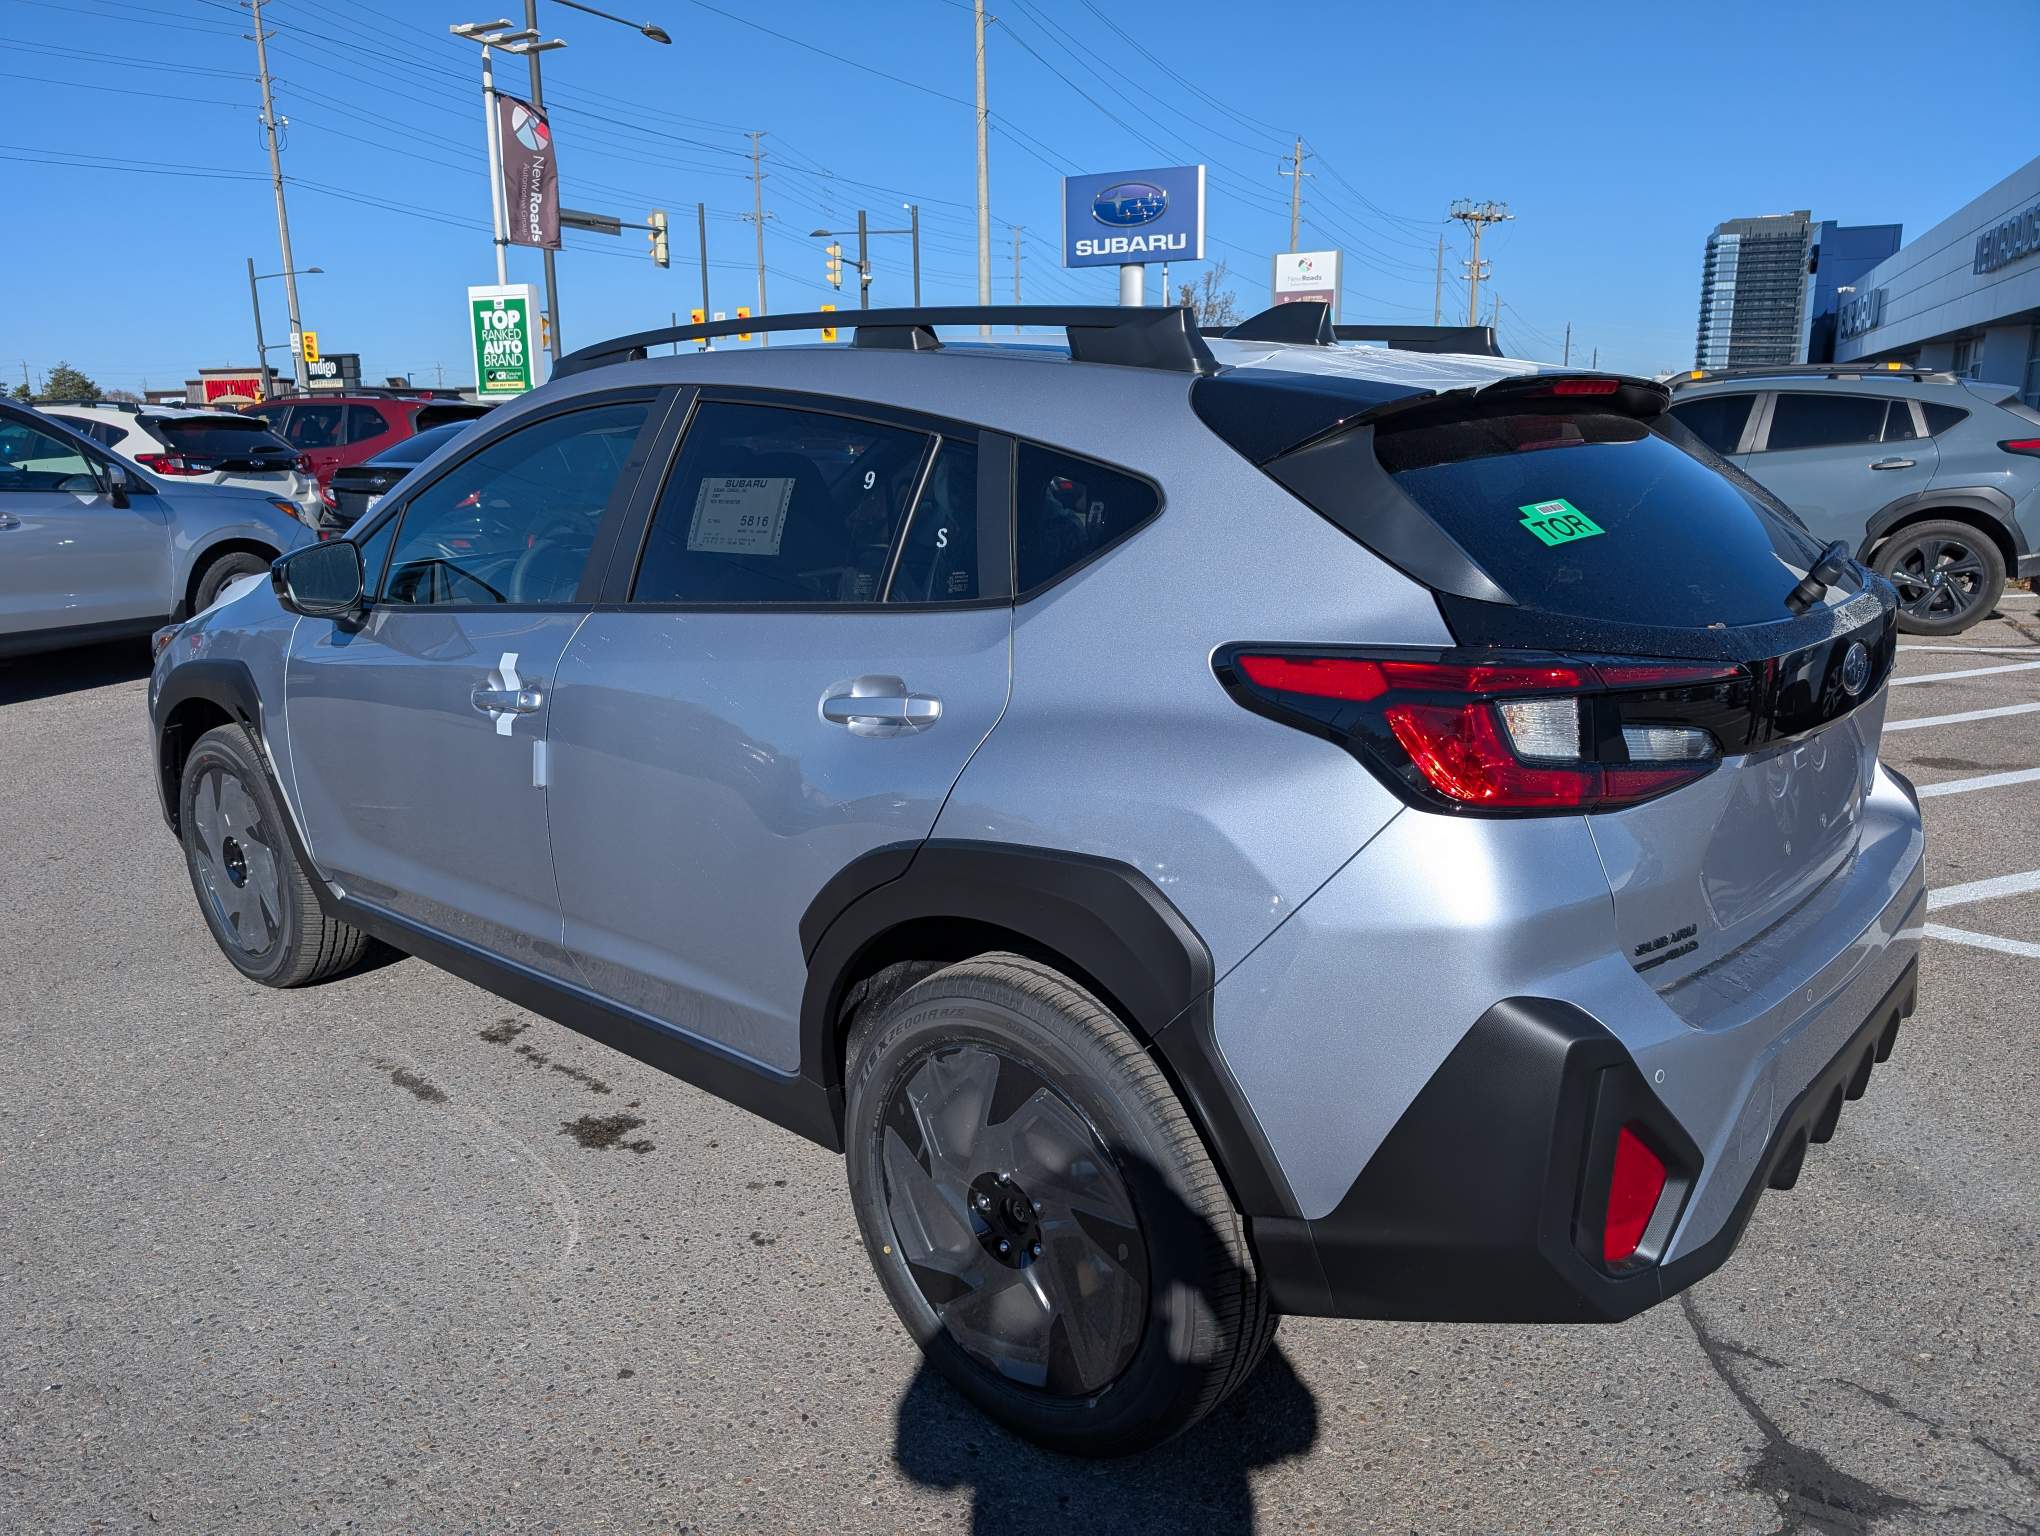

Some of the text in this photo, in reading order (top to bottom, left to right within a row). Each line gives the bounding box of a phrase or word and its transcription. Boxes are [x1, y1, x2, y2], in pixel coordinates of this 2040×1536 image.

[520, 163, 529, 236] Automotive Group
[530, 155, 544, 242] NewRoads
[1076, 233, 1186, 256] SUBARU
[480, 310, 520, 330] TOP
[482, 329, 522, 341] RANKED
[484, 340, 522, 354] AUTO
[484, 353, 523, 367] BRAND
[725, 479, 768, 489] SUBARU
[864, 471, 876, 489] 9
[740, 515, 769, 527] 5816
[1531, 514, 1593, 540] TOR
[936, 527, 948, 548] S
